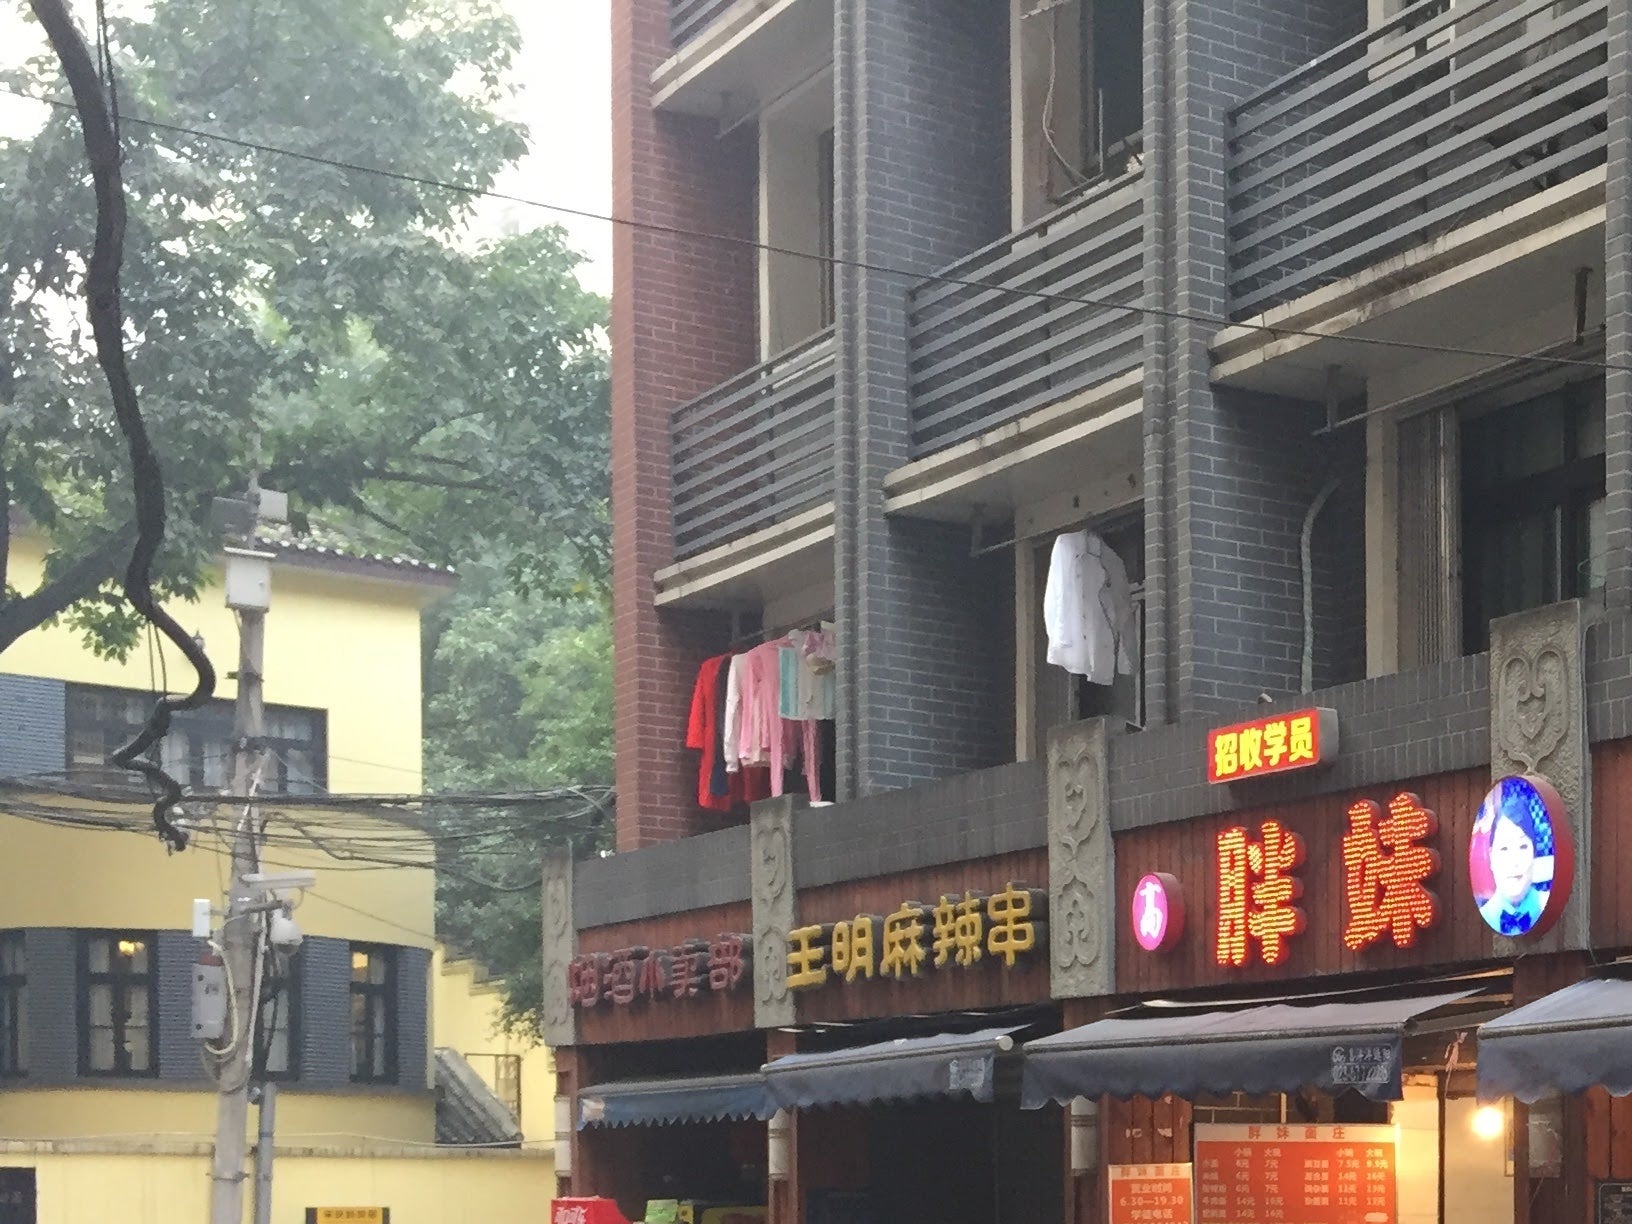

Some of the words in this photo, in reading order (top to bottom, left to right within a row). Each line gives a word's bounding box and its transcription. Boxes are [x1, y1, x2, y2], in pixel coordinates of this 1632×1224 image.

[1213, 715, 1315, 778] 招收学员
[1216, 792, 1436, 966] 胖妹
[783, 881, 1036, 989] 王明麻辣串
